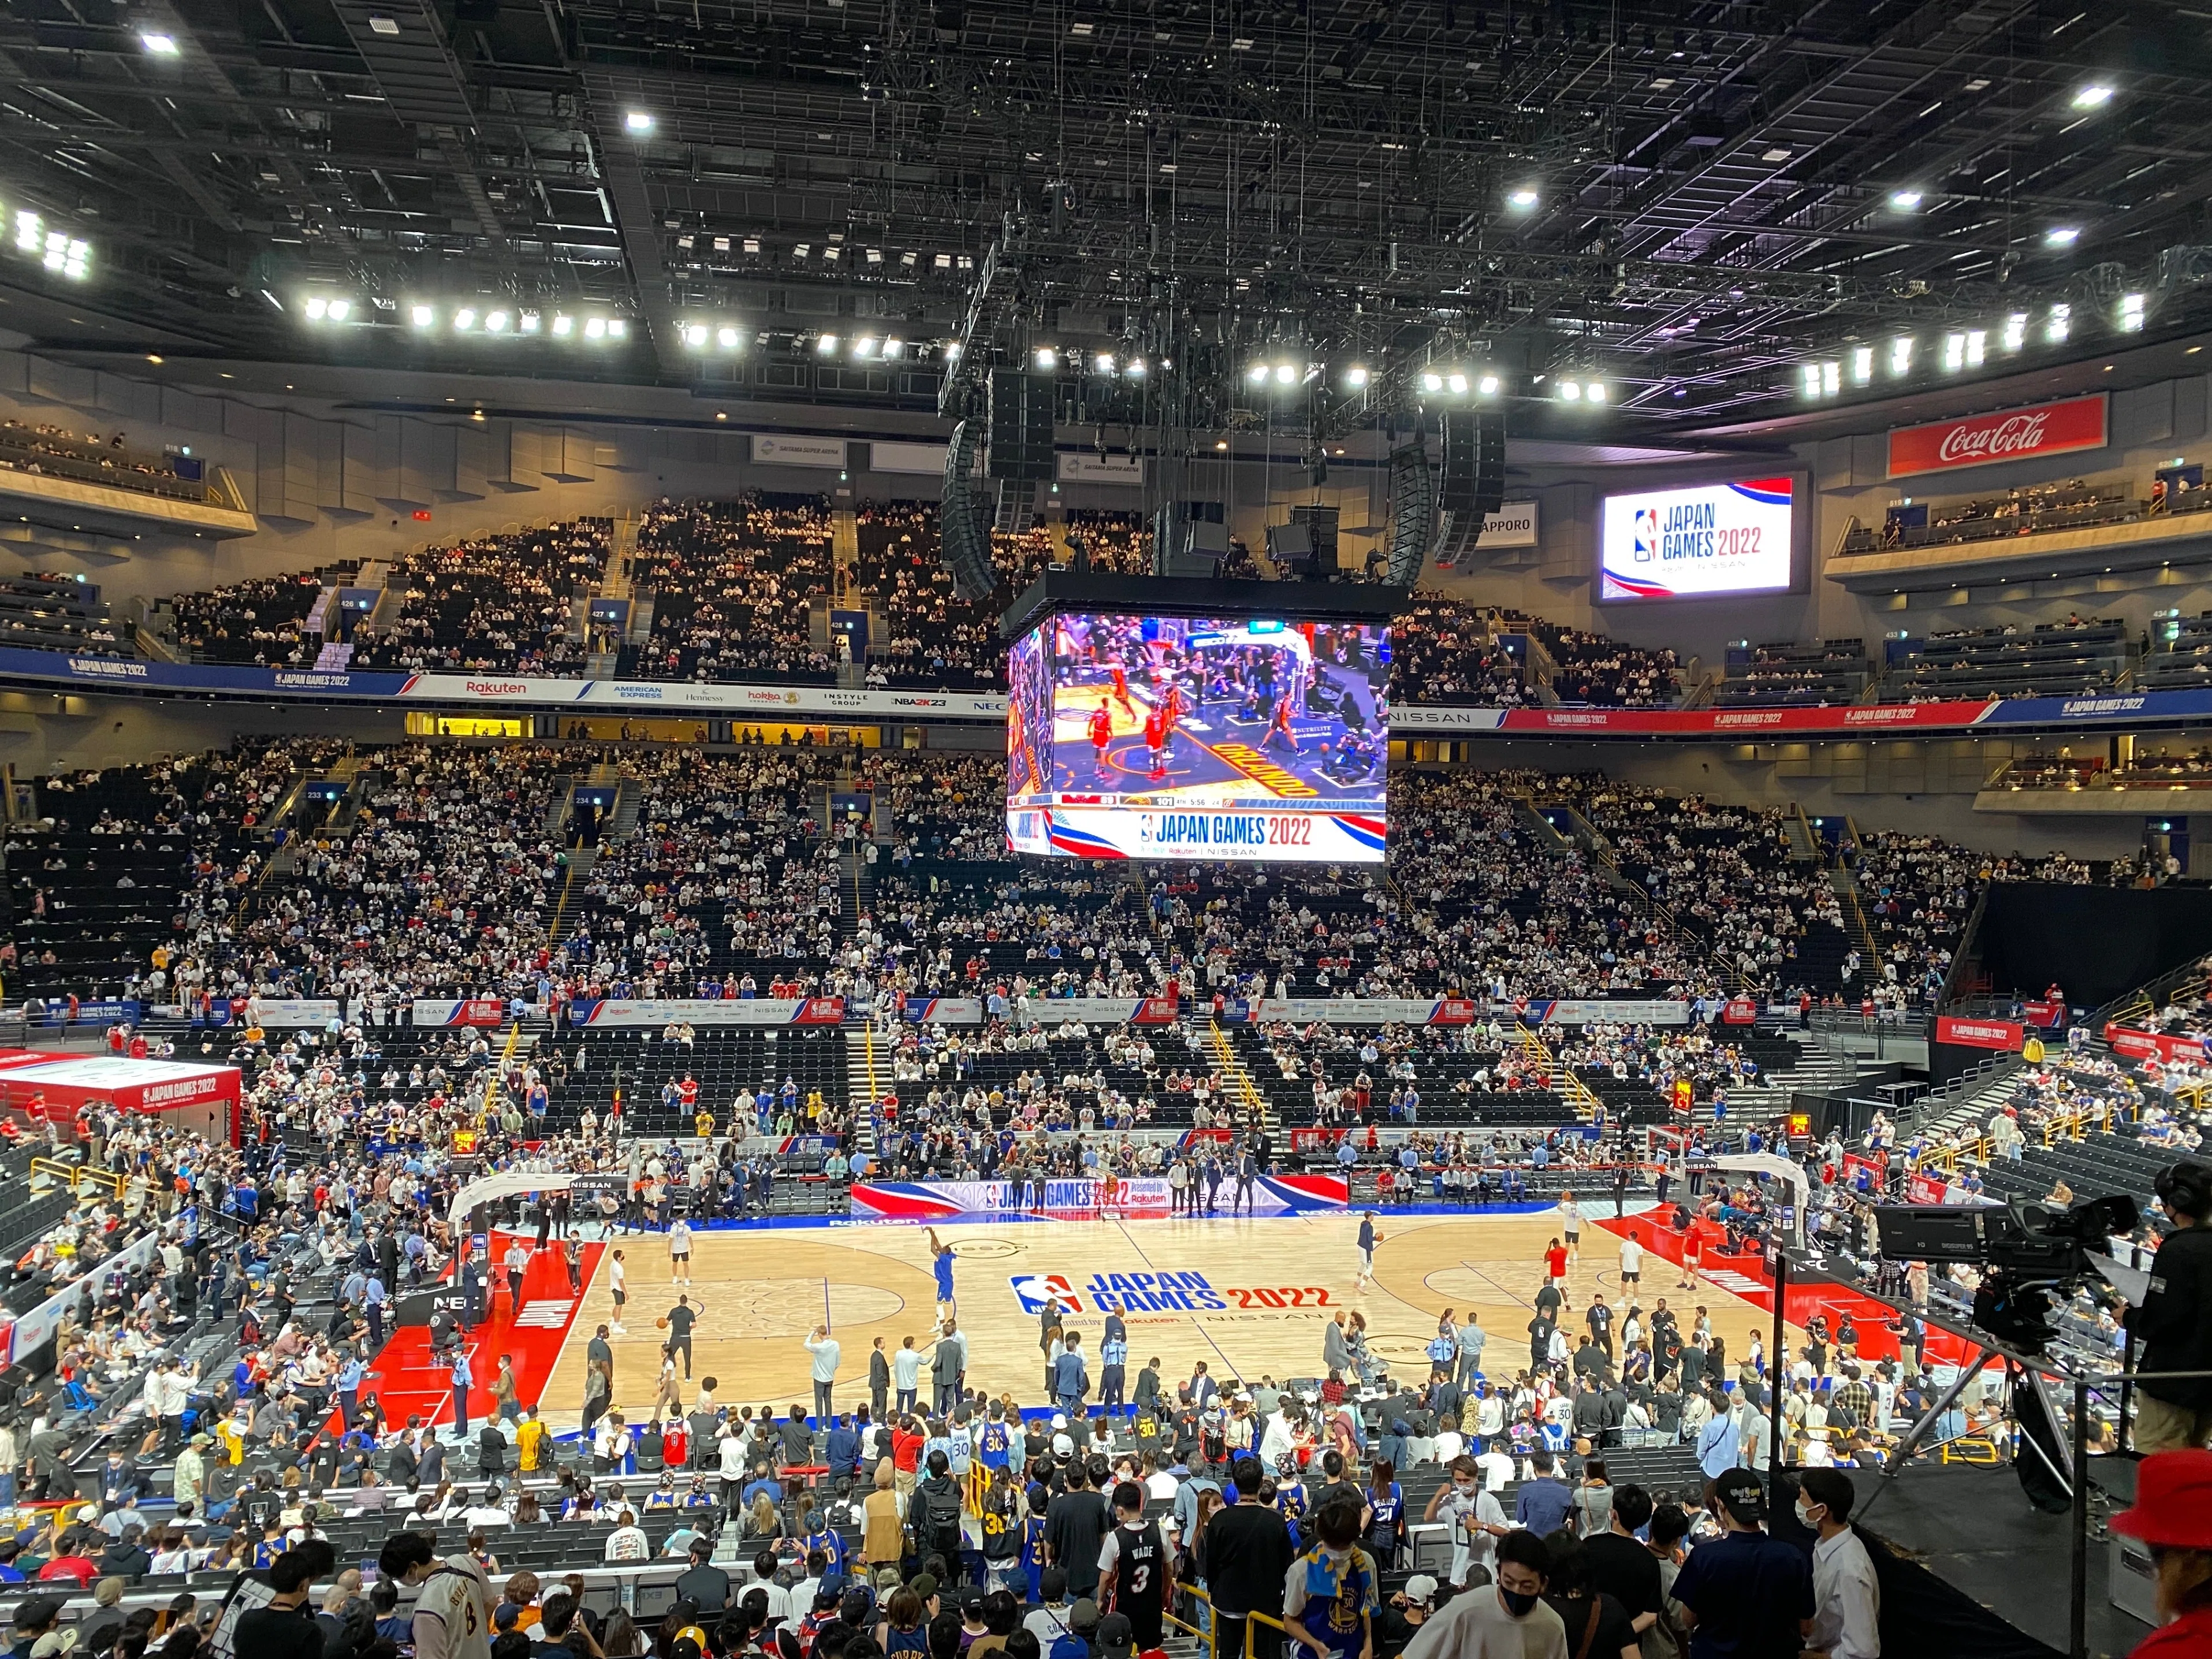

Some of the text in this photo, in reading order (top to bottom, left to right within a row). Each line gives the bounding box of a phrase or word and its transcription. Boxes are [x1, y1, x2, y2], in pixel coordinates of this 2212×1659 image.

[1940, 412, 2051, 461] Coca-Cola
[1664, 502, 1715, 532] JAPAN
[1482, 519, 1530, 533] APPORO
[1663, 527, 1761, 560] GAMES 2022
[76, 659, 102, 672] JAPAN
[102, 662, 126, 674] GAMES
[126, 664, 147, 676] 2022
[282, 675, 306, 685] JAPAN
[306, 675, 330, 685] GAMES
[330, 676, 349, 686] 2022
[466, 682, 526, 694] Rakuten
[686, 693, 724, 702] Hennessy
[895, 698, 947, 706] NBA2K23
[2070, 698, 2144, 712] JAPAN GAMES 2022
[1388, 713, 1470, 723] NISSAN
[1552, 715, 1607, 724] JAPAN GAMES 2022
[1721, 713, 1782, 723] JAPAN GAMES 2022
[1852, 708, 1916, 720] JAPAN GAMES 2022
[1026, 745, 1041, 792] ORLANDO
[1211, 743, 1320, 798] ORLANDO
[1100, 795, 1114, 804] 89
[1157, 797, 1174, 806] 101
[1157, 815, 1310, 845] JAPAN GAMES 2022
[1169, 847, 1197, 856] Rakuten
[1957, 1025, 2007, 1039] JAPAN GAMES 2022
[150, 1078, 216, 1102] JAPAN GAMES 2022
[1677, 1091, 1688, 1108] 24
[1795, 1125, 1805, 1133] 24
[457, 1141, 470, 1151] 24
[1131, 1182, 1163, 1193] Presented by
[1047, 1182, 1090, 1207] GAMES
[1131, 1194, 1166, 1203] Rakuten
[2002, 1222, 2006, 1231] 1
[1087, 1271, 1213, 1293] JAPAN
[1699, 1268, 1773, 1293] JAPAN
[1092, 1288, 1343, 1312] GAMES 2022
[514, 1300, 575, 1329] JAPAN
[1122, 1318, 1179, 1326] akuten
[1559, 1409, 1570, 1420] 30
[1139, 1423, 1156, 1438] 30
[953, 1442, 969, 1457] 30
[986, 1437, 1003, 1452] 30
[1098, 1444, 1110, 1454] 30
[501, 1502, 518, 1515] 30
[1132, 1546, 1153, 1561] WADE
[1131, 1565, 1150, 1594] 3
[1343, 1597, 1354, 1608] 30
[891, 1649, 925, 1659] CURRY
